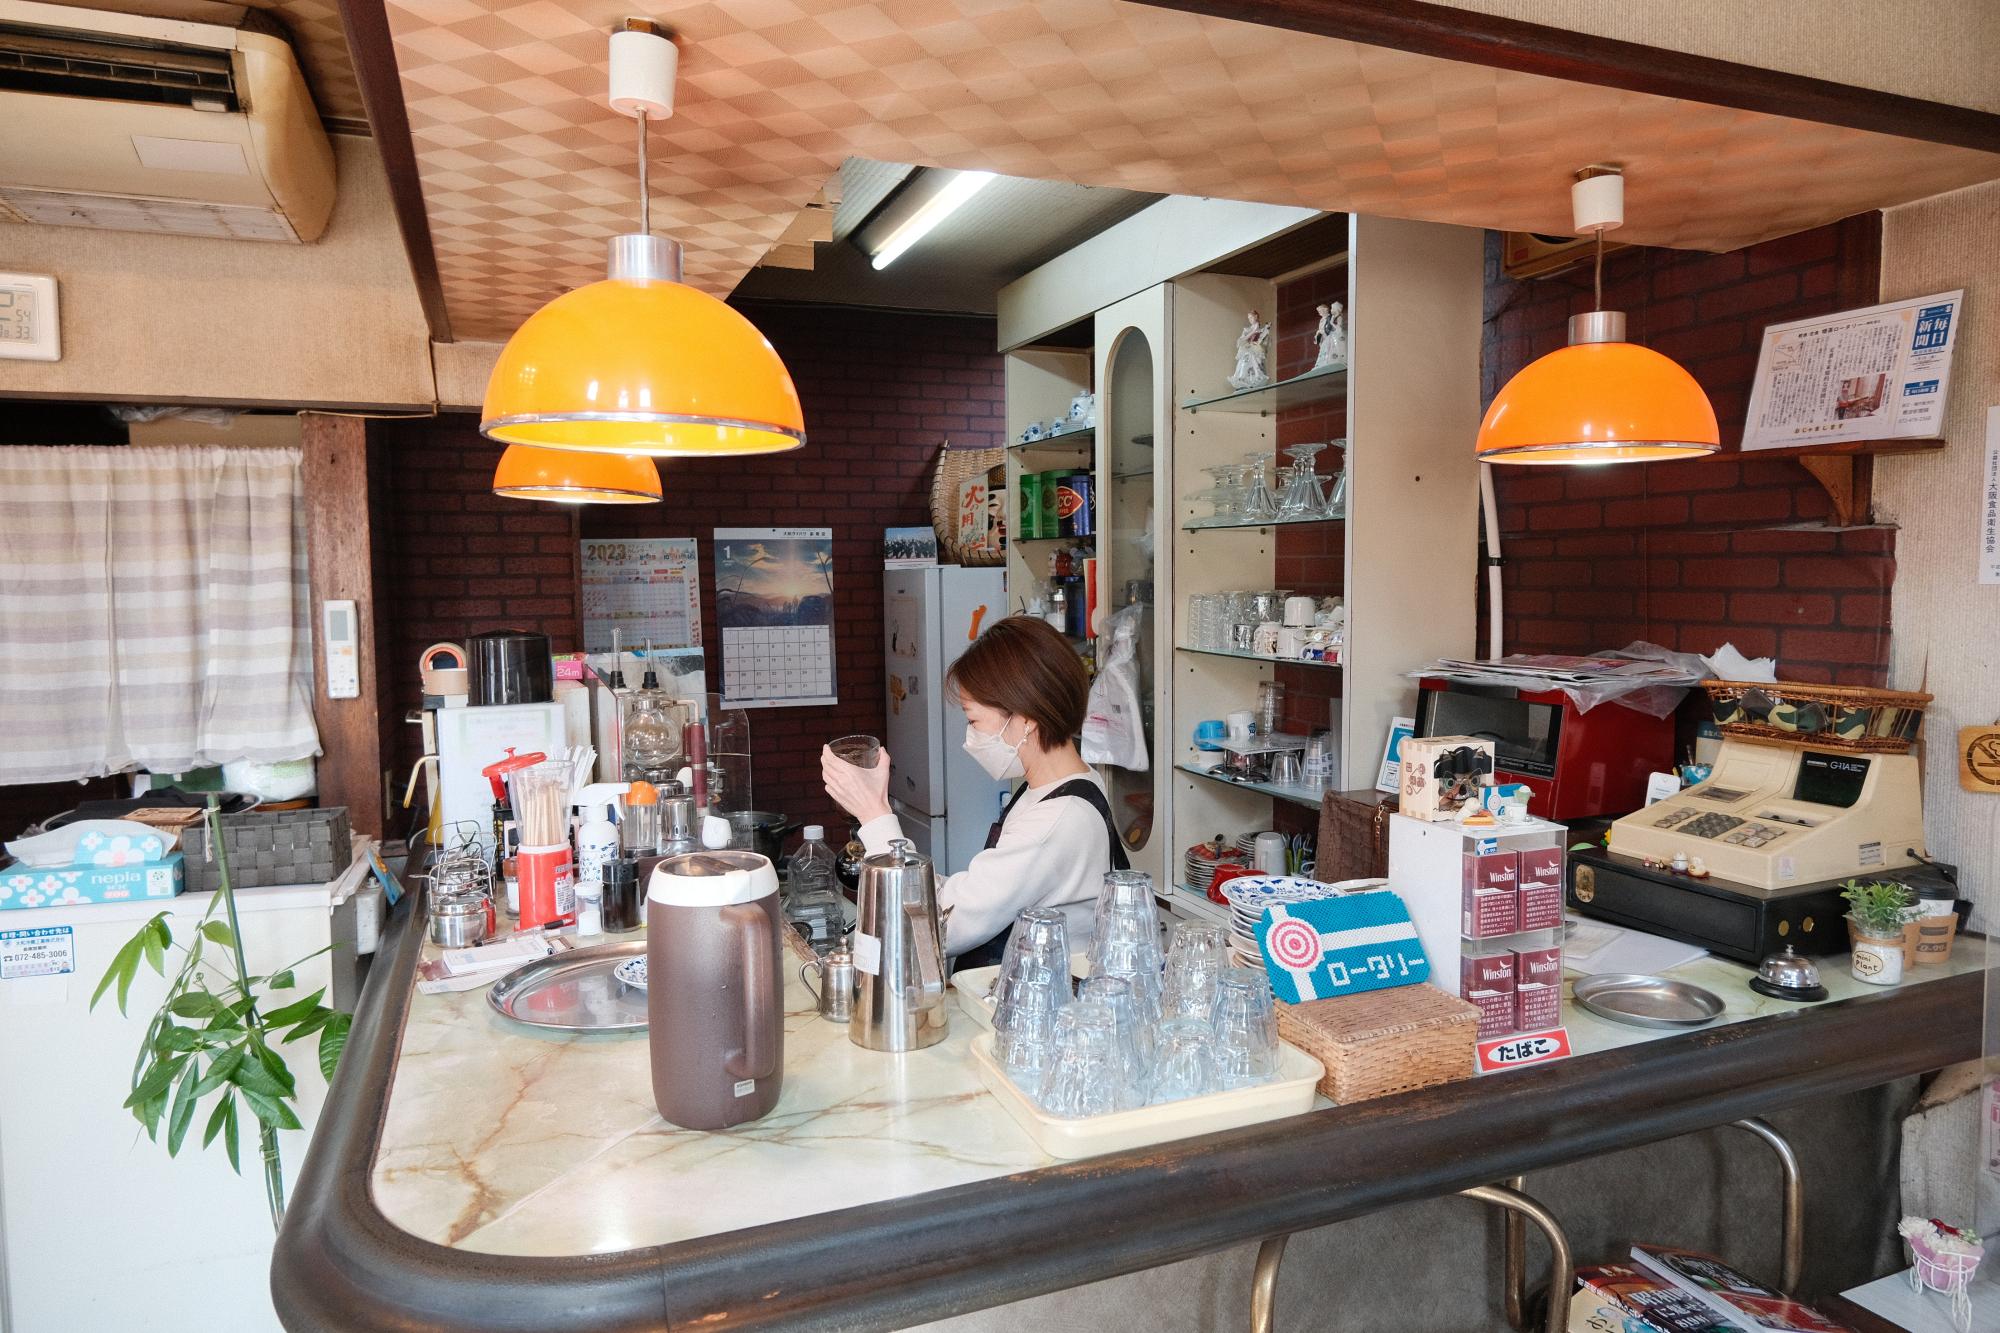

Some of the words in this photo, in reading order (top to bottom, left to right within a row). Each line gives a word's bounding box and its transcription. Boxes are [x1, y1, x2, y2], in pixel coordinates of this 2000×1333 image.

[1985, 483, 1998, 553] 大阪食品衛生協会
[587, 544, 627, 560] 2023
[723, 545, 731, 559] 1
[556, 667, 580, 677] 24m
[90, 871, 142, 885] nepia
[1490, 870, 1515, 883] Winston
[1535, 866, 1559, 877] Winston
[14, 950, 68, 961] 072-485-3006
[1856, 953, 1871, 962] mini
[1530, 961, 1558, 974] Winston
[1482, 968, 1512, 981] Winston
[1498, 1038, 1551, 1062] たばこ
